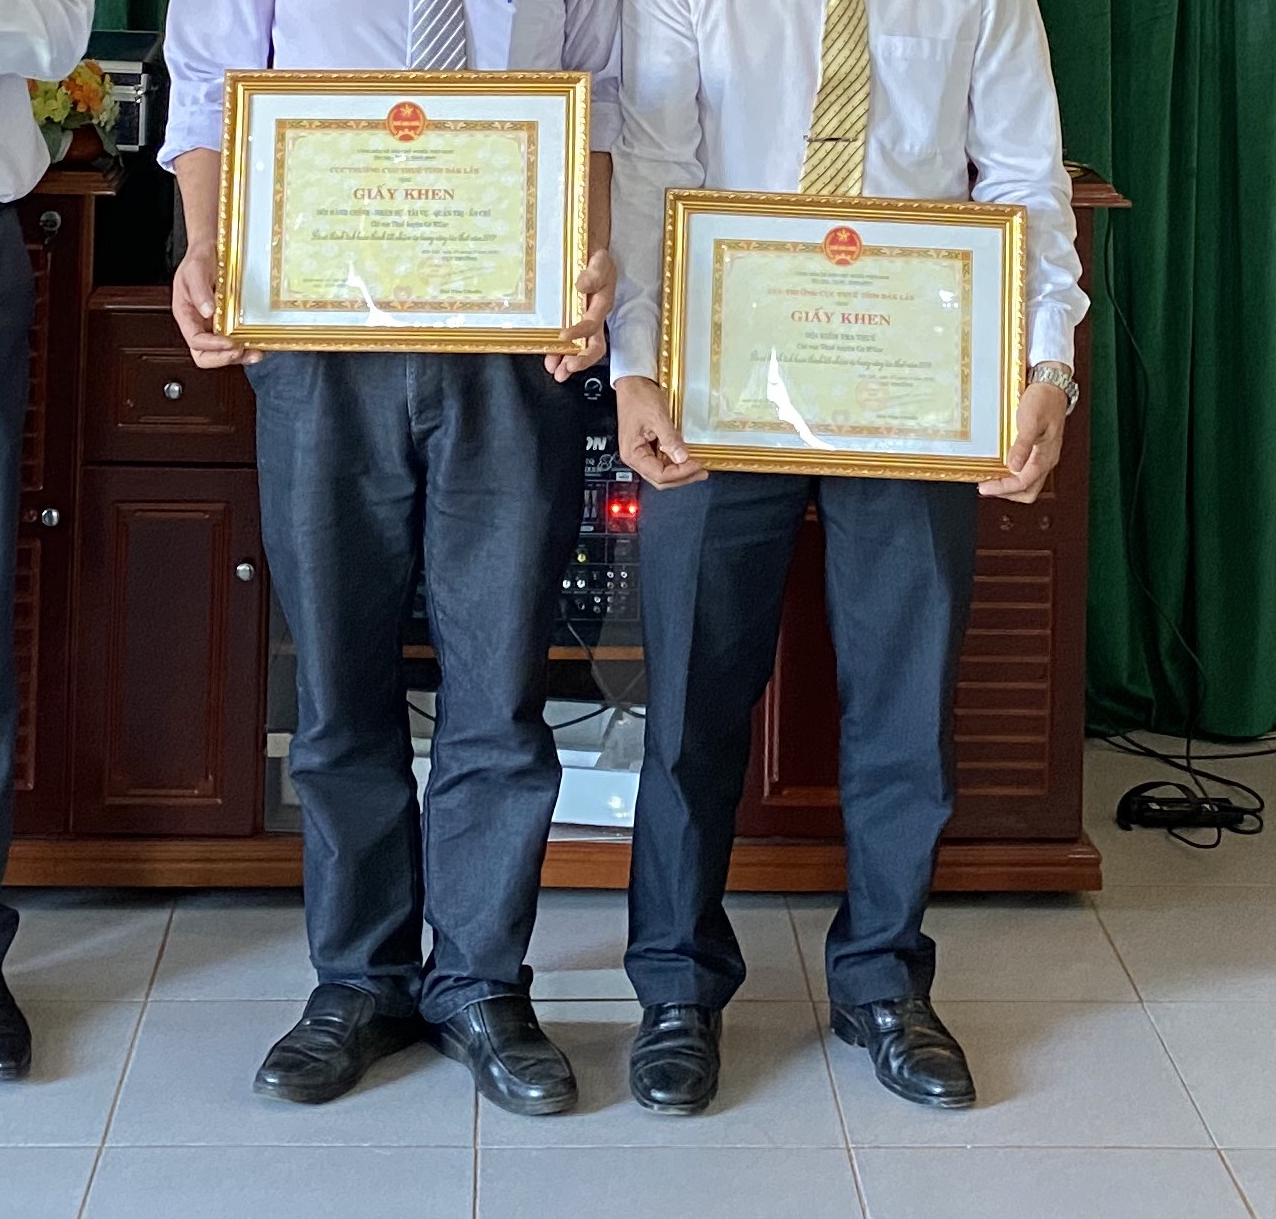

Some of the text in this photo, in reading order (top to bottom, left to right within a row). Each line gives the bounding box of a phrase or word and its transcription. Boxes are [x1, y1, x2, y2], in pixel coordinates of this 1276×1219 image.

[353, 183, 455, 201] GIẤY KHEN
[790, 307, 891, 326] GIẤY KHEN
